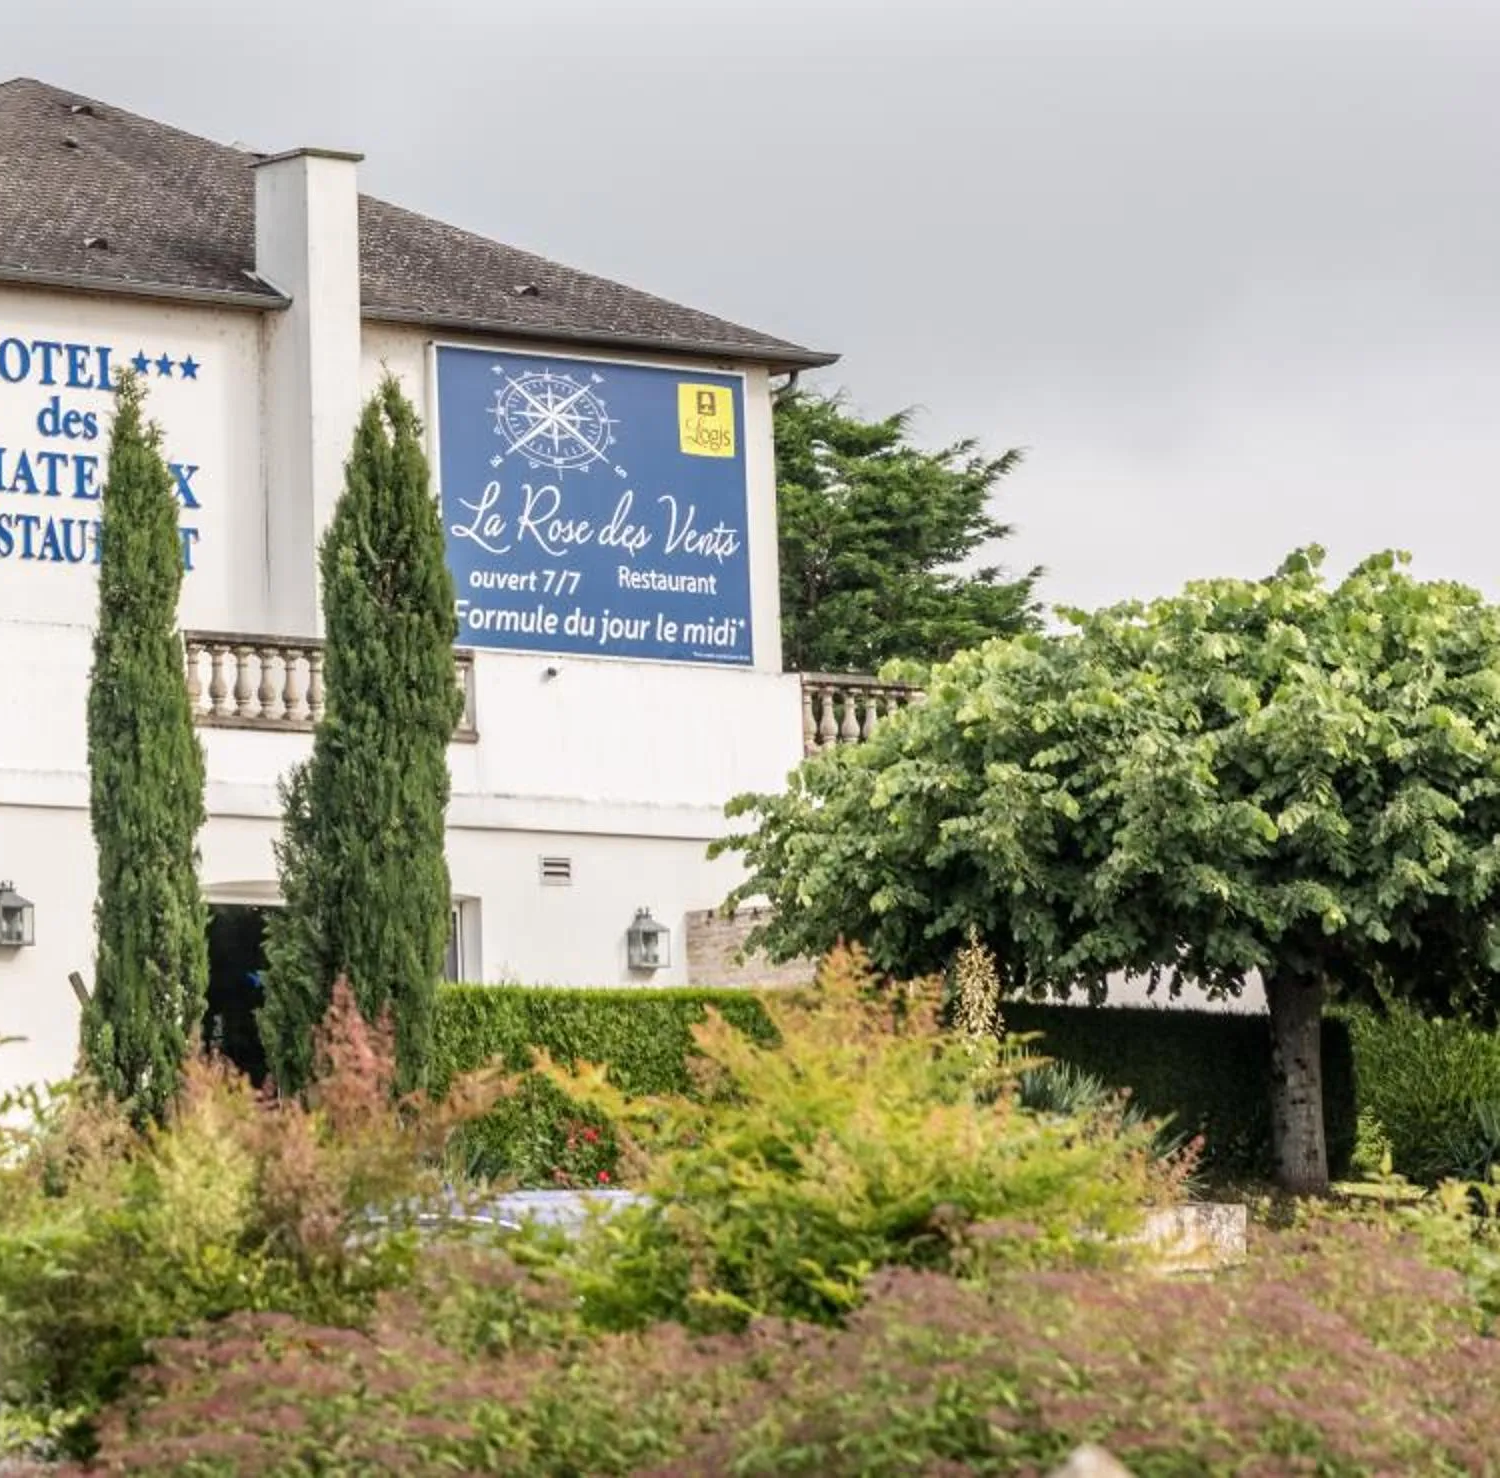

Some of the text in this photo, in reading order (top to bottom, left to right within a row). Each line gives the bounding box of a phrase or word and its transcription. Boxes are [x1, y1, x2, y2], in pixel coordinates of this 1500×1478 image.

[37, 396, 98, 440] des
[451, 481, 741, 564] La Rose des Vents
[469, 569, 581, 596] ouvert 7/7
[617, 565, 717, 595] Restaurant
[453, 599, 559, 636] Formule
[563, 606, 596, 637] du
[600, 609, 651, 644] jour
[656, 613, 678, 642] le
